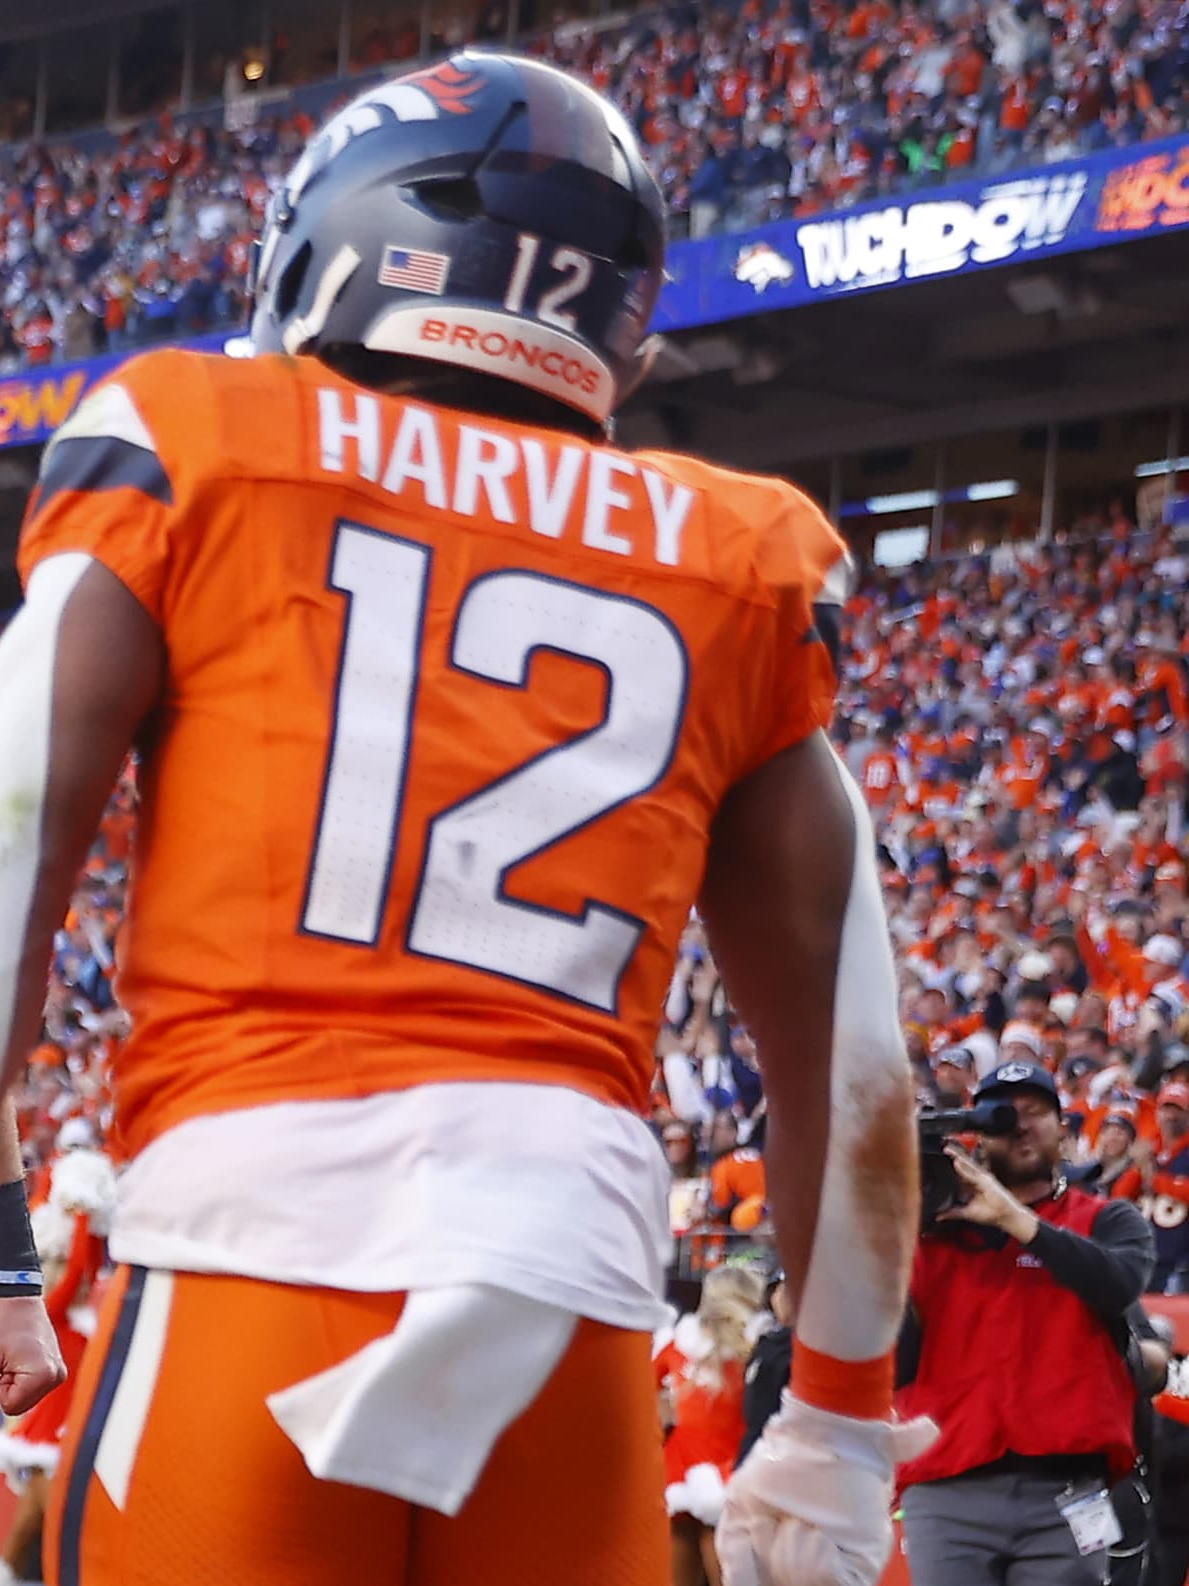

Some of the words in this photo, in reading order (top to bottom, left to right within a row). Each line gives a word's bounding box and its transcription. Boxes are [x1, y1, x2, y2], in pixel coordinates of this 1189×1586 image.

[504, 231, 591, 333] 12
[419, 319, 601, 394] BRONCOS
[317, 390, 693, 566] HARVEY
[298, 516, 691, 1020] 12
